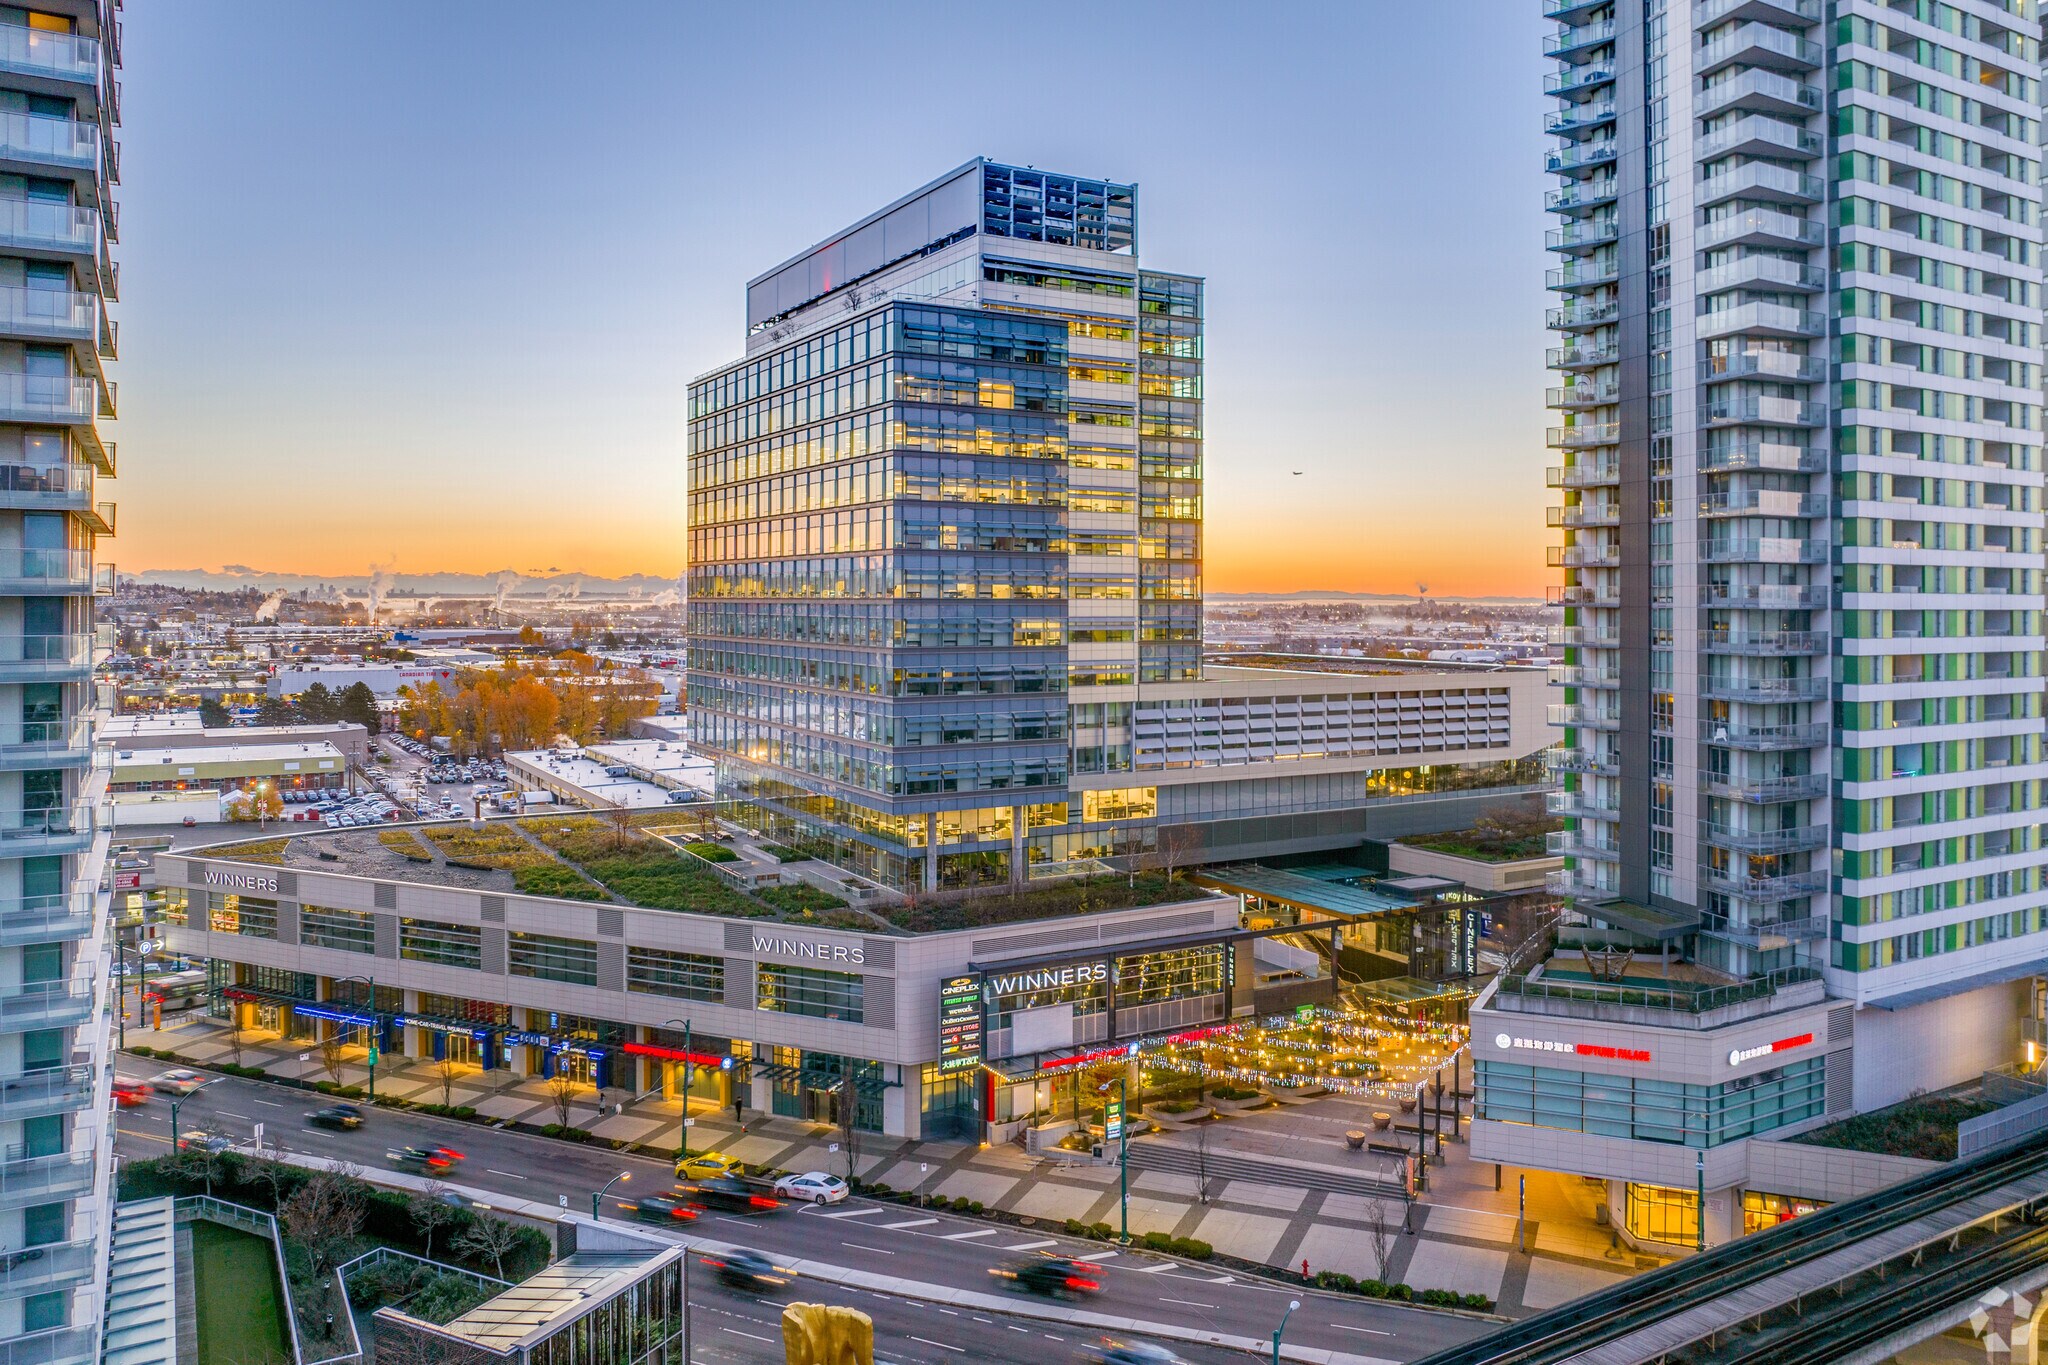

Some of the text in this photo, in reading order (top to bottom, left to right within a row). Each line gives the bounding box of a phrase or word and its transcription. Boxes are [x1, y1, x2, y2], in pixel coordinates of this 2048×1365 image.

[205, 871, 278, 892] WINNERS
[752, 936, 865, 964] WINNERS
[1467, 913, 1475, 973] CINEPLEX
[942, 984, 979, 994] CINEPLEX
[993, 964, 1107, 995] WINNERS
[961, 1055, 979, 1066] T&T
